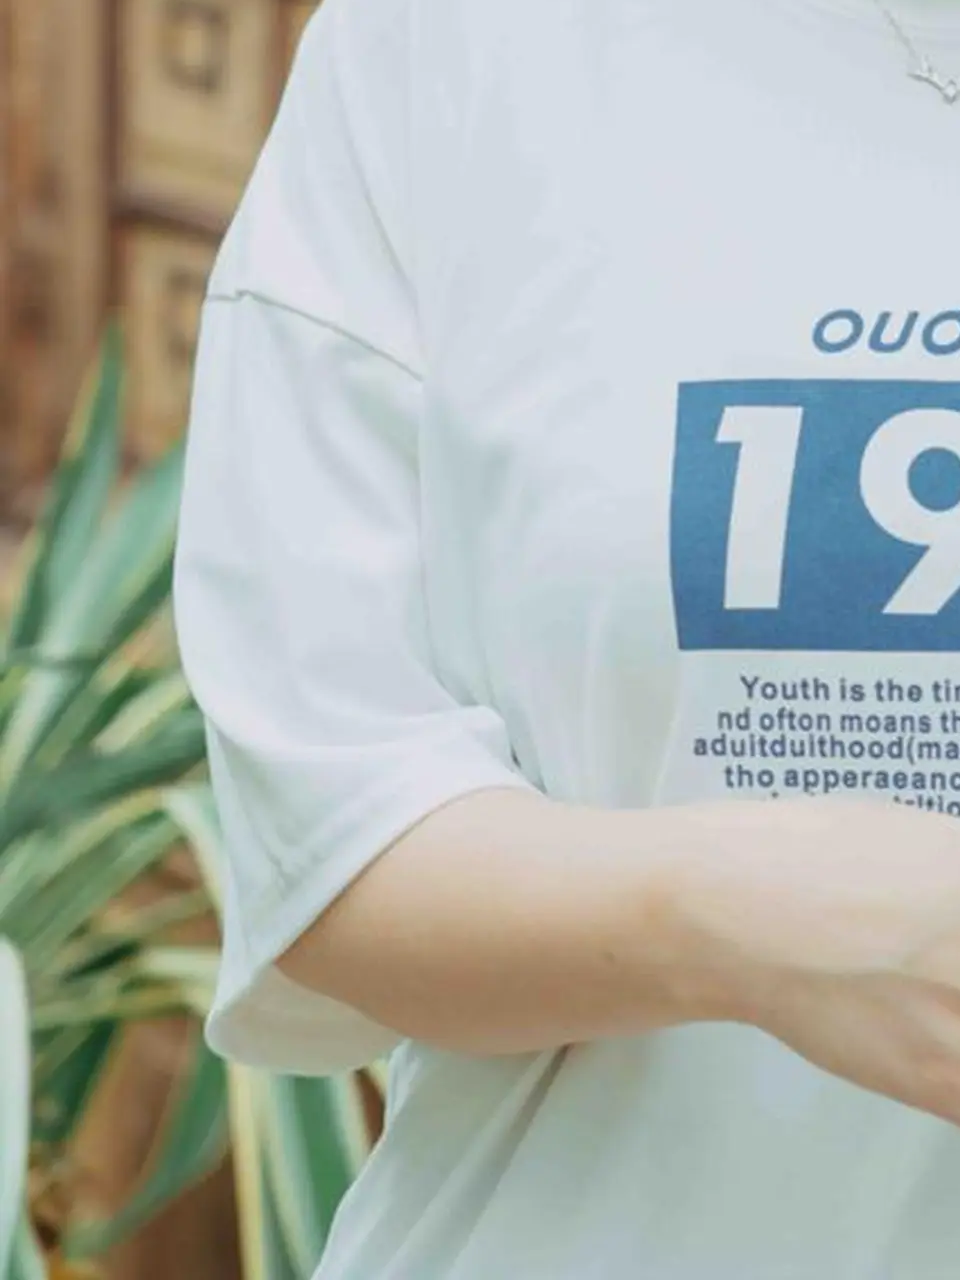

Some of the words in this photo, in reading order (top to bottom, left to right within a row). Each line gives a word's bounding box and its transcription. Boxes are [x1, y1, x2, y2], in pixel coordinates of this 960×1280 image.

[740, 675, 831, 702] Youth
[839, 677, 866, 702] is
[874, 680, 924, 703] the
[717, 706, 751, 731] nd
[759, 706, 831, 732] ofton
[839, 712, 932, 735] moans
[724, 765, 775, 789] tho
